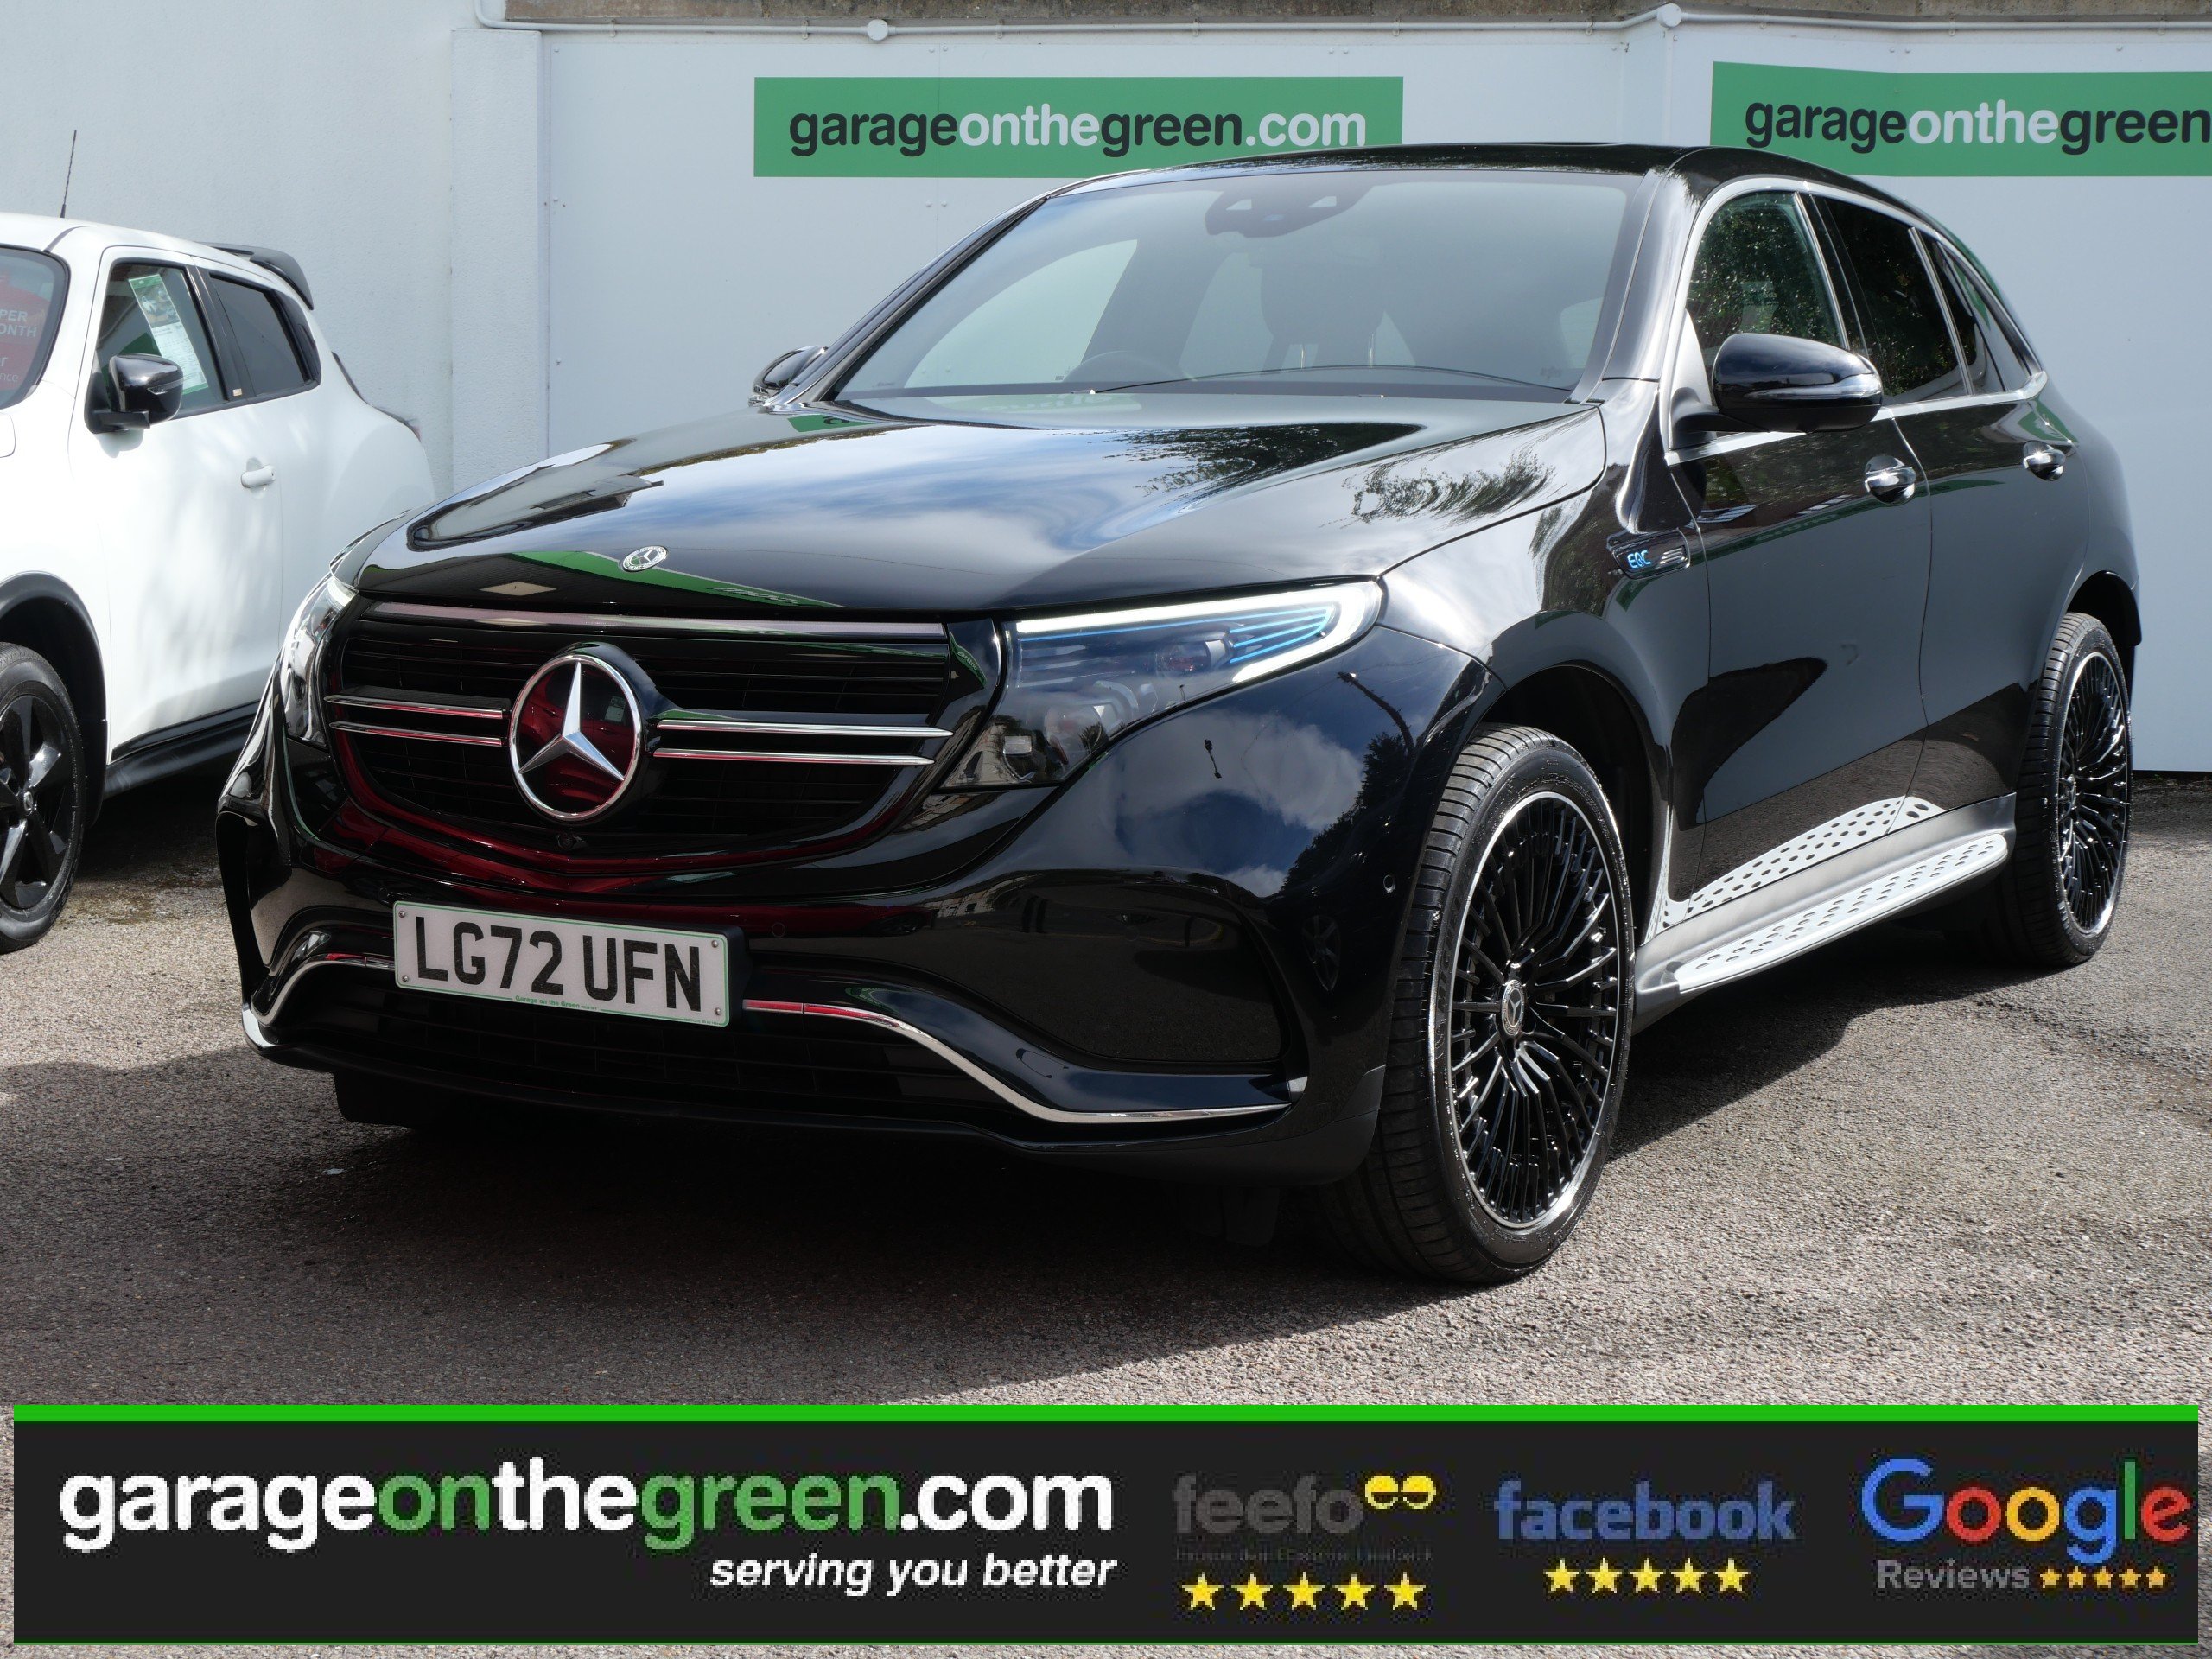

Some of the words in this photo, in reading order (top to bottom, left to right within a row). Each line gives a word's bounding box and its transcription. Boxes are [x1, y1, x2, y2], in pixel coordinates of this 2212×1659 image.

[789, 103, 1367, 157] garageonthegreen.com
[1745, 99, 2211, 156] garageonthegreen
[1627, 550, 1651, 569] EQC
[416, 916, 564, 996] LG72
[582, 935, 702, 1012] UFN
[515, 995, 538, 1004] Garage
[561, 1001, 581, 1009] Green
